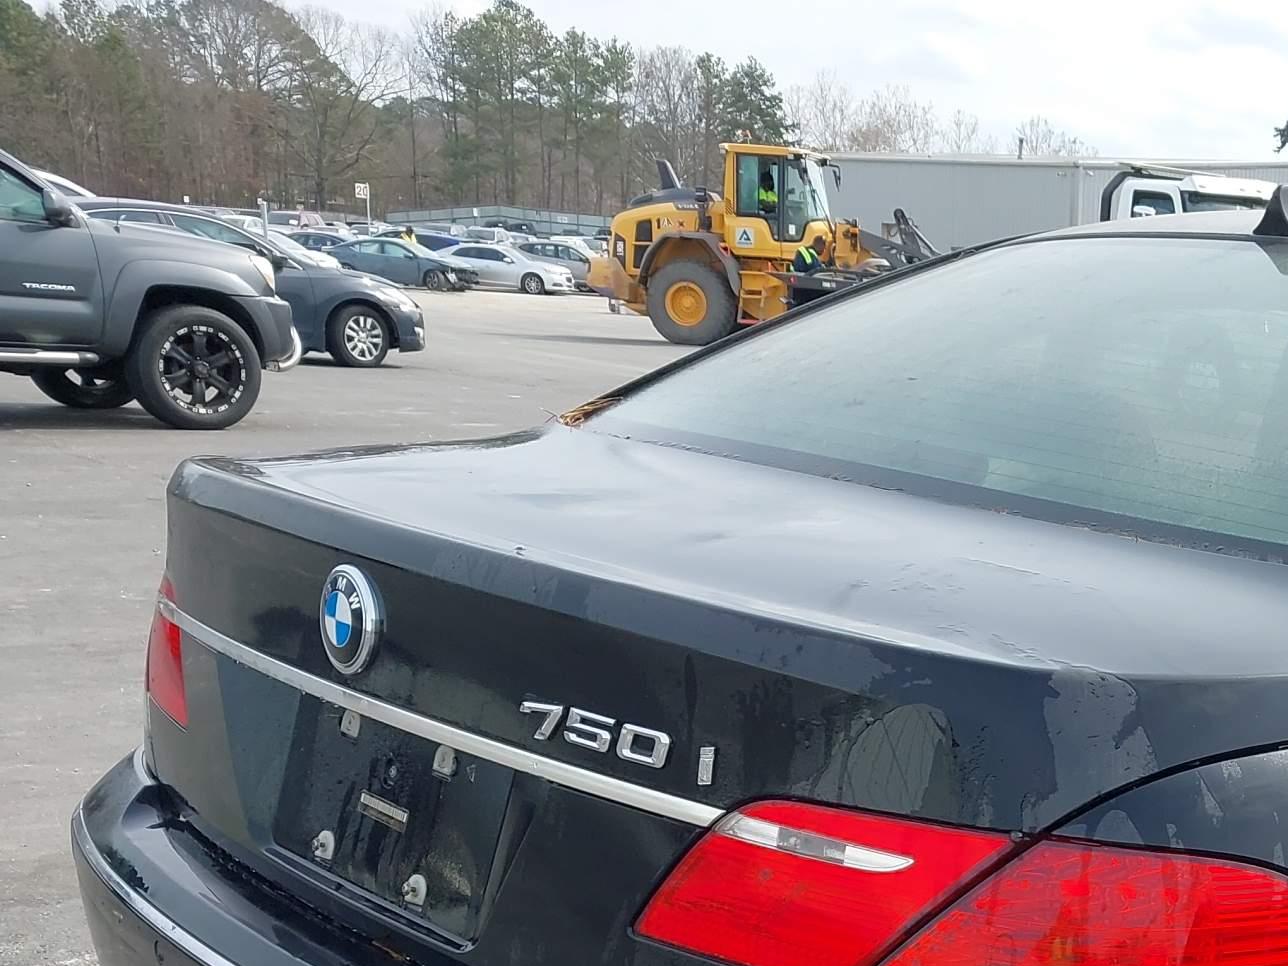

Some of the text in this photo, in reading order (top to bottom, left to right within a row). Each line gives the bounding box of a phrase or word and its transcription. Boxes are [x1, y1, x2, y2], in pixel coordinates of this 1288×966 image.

[21, 282, 76, 292] TACOMA
[519, 701, 716, 785] 750 i
